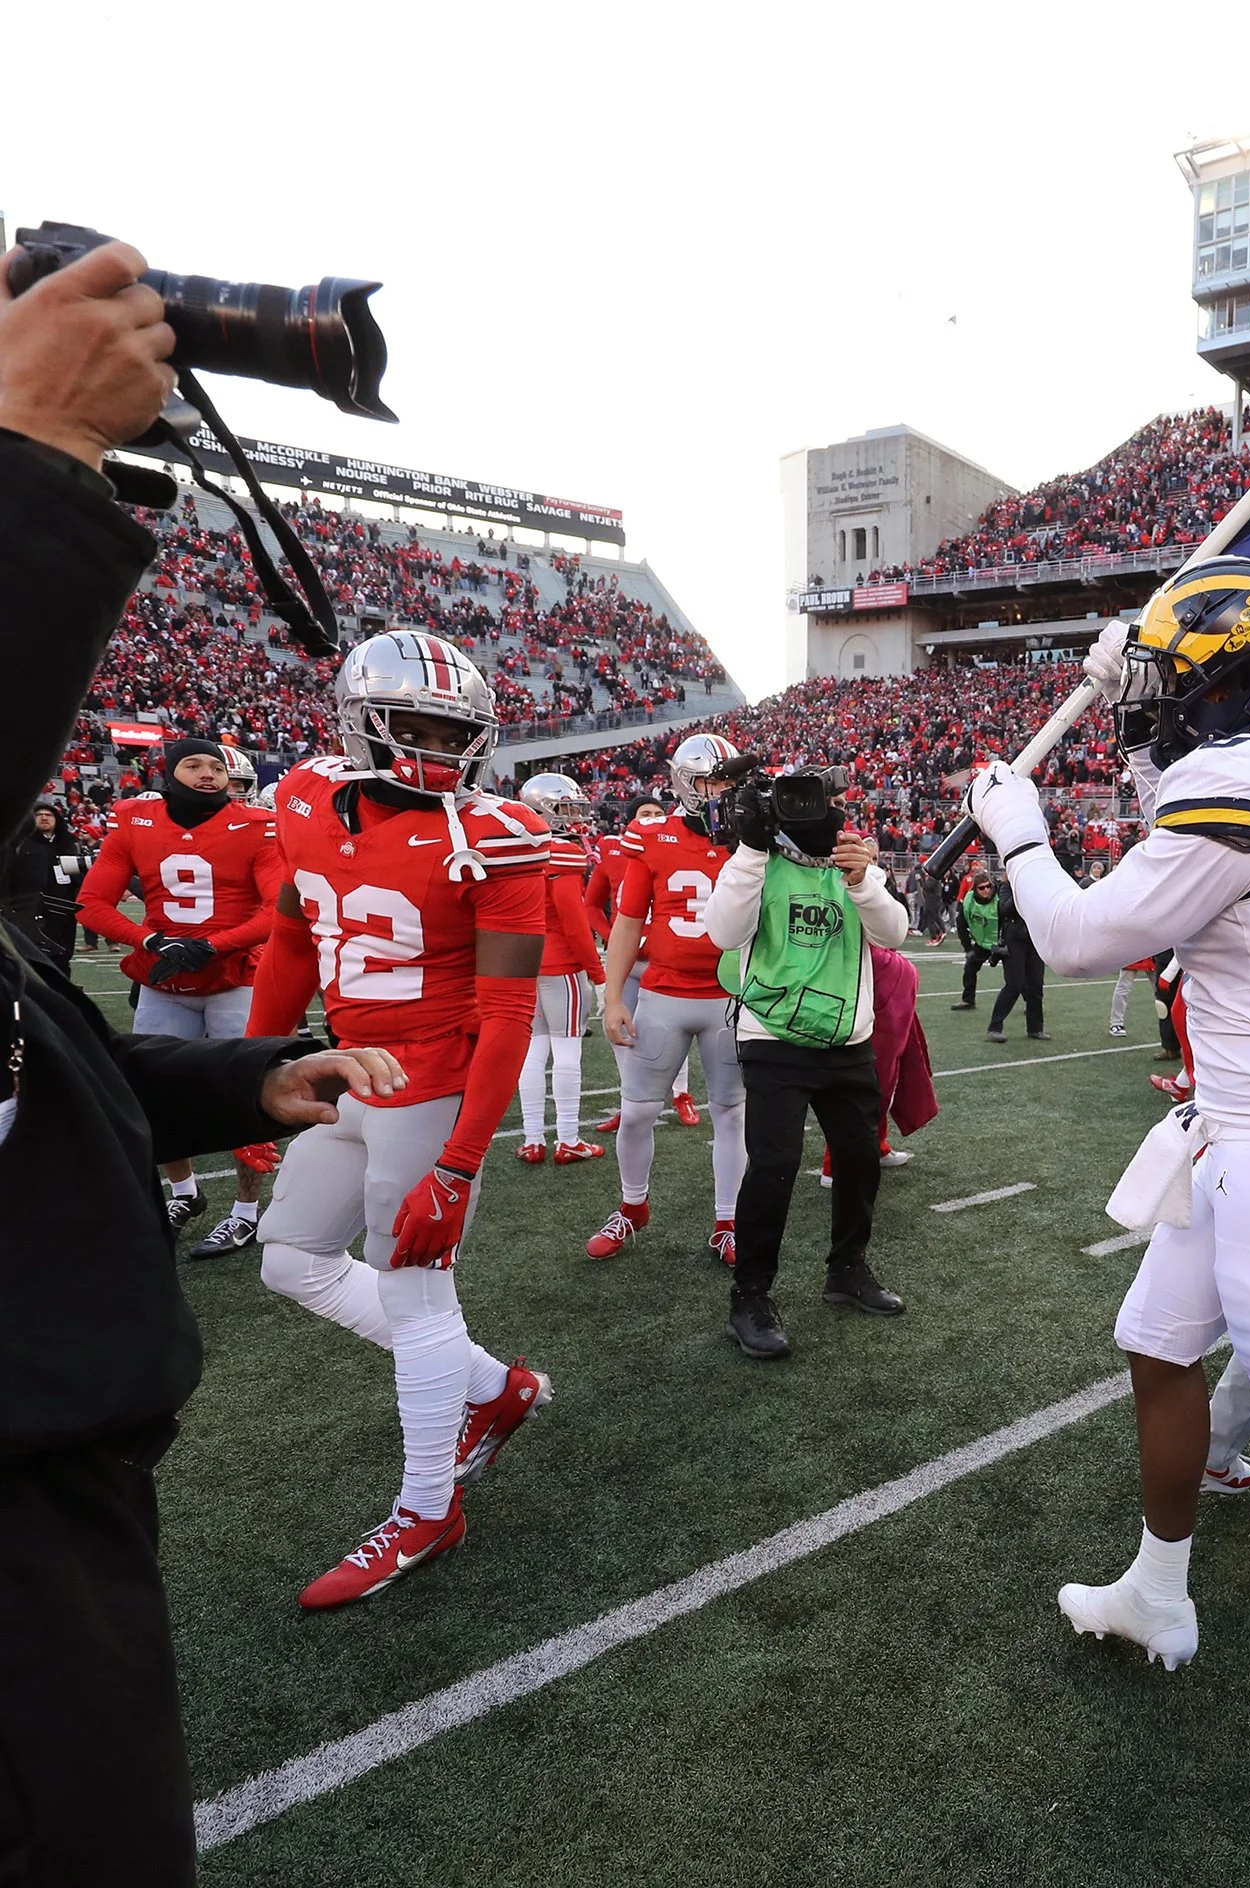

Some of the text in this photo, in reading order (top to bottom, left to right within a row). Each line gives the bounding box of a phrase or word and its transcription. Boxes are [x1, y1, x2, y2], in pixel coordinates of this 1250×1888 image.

[257, 441, 330, 465] McCORKLE
[336, 466, 388, 485] NOURSE
[347, 459, 468, 490] HUNTINGTON BANK
[322, 480, 363, 495] NETJETS
[413, 481, 452, 497] PRIOR
[478, 483, 534, 502] WEBSTER
[373, 489, 404, 502] Official
[447, 502, 465, 513] Ohio
[466, 505, 487, 517] State
[465, 490, 518, 509] RITE RUG
[526, 503, 571, 519] SAVAGE
[579, 511, 624, 528] NETJETS
[800, 593, 820, 607] PAUL
[821, 590, 850, 605] BROWN
[160, 853, 214, 925] 9
[789, 902, 831, 928] FOX
[788, 924, 832, 937] SPORTS
